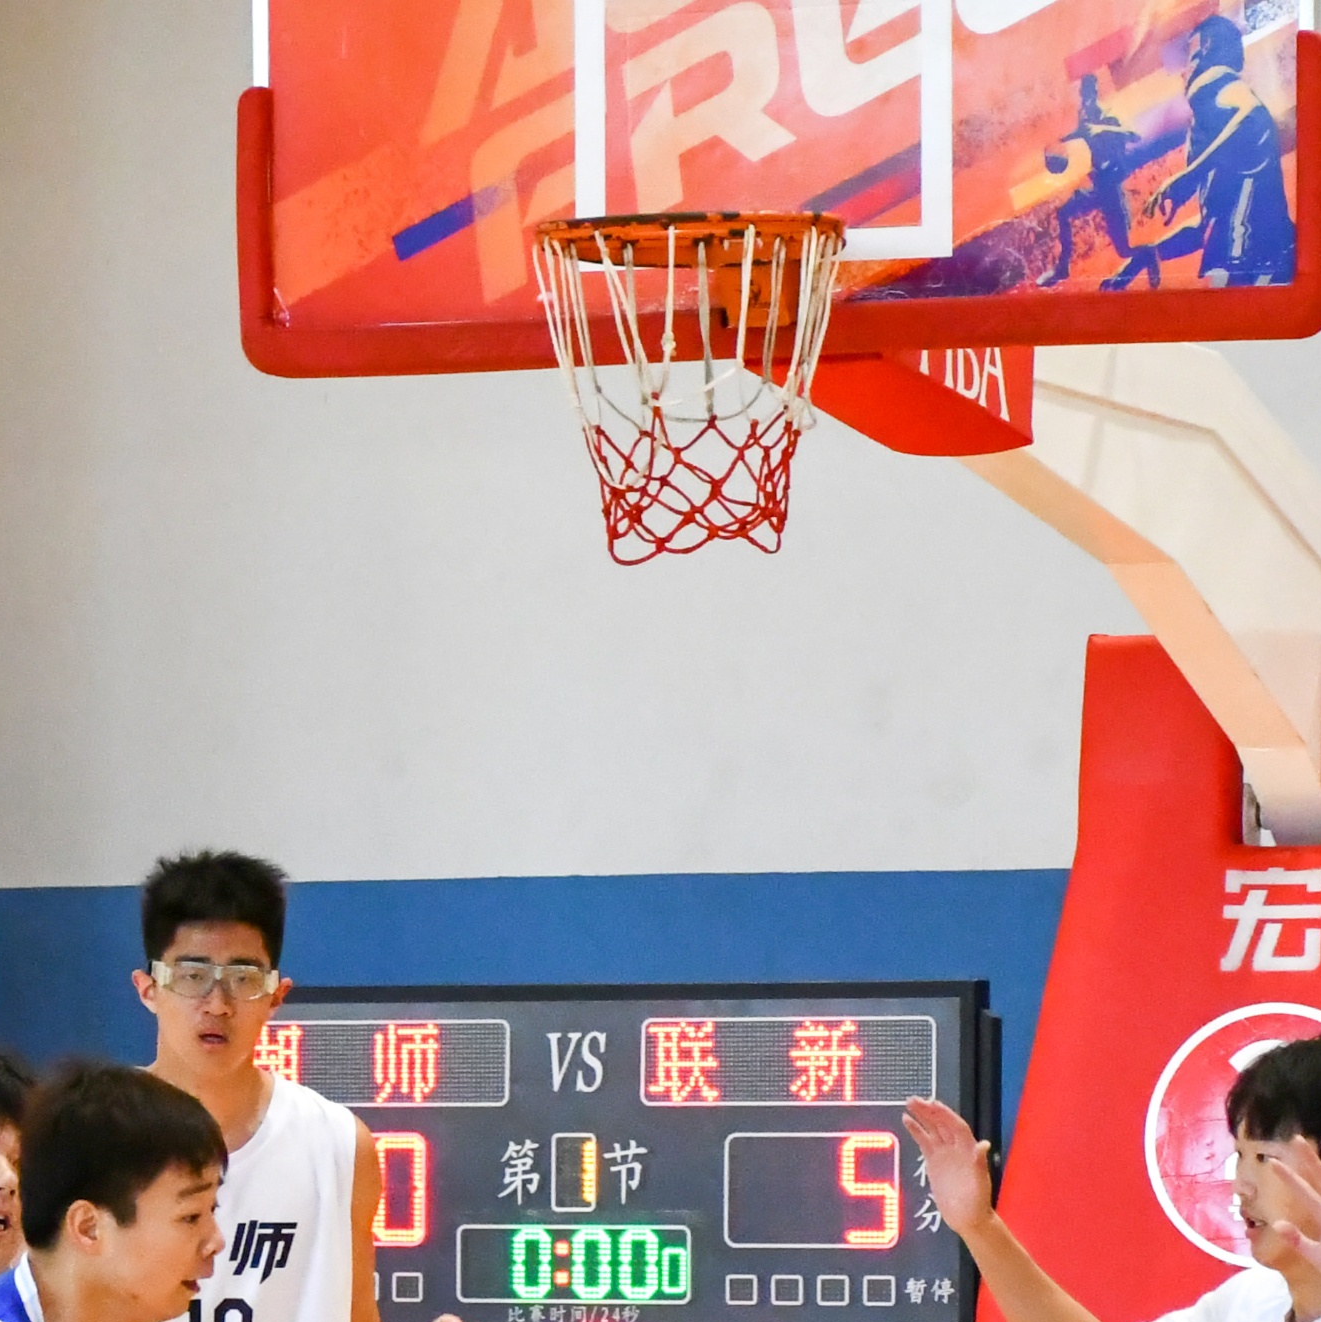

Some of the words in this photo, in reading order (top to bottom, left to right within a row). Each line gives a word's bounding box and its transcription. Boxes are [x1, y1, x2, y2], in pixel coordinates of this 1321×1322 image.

[545, 1031, 607, 1094] VS
[647, 1020, 862, 1102] 联新
[841, 1135, 899, 1245] 5
[228, 1219, 298, 1285] 师
[903, 1277, 956, 1305] 暂停
